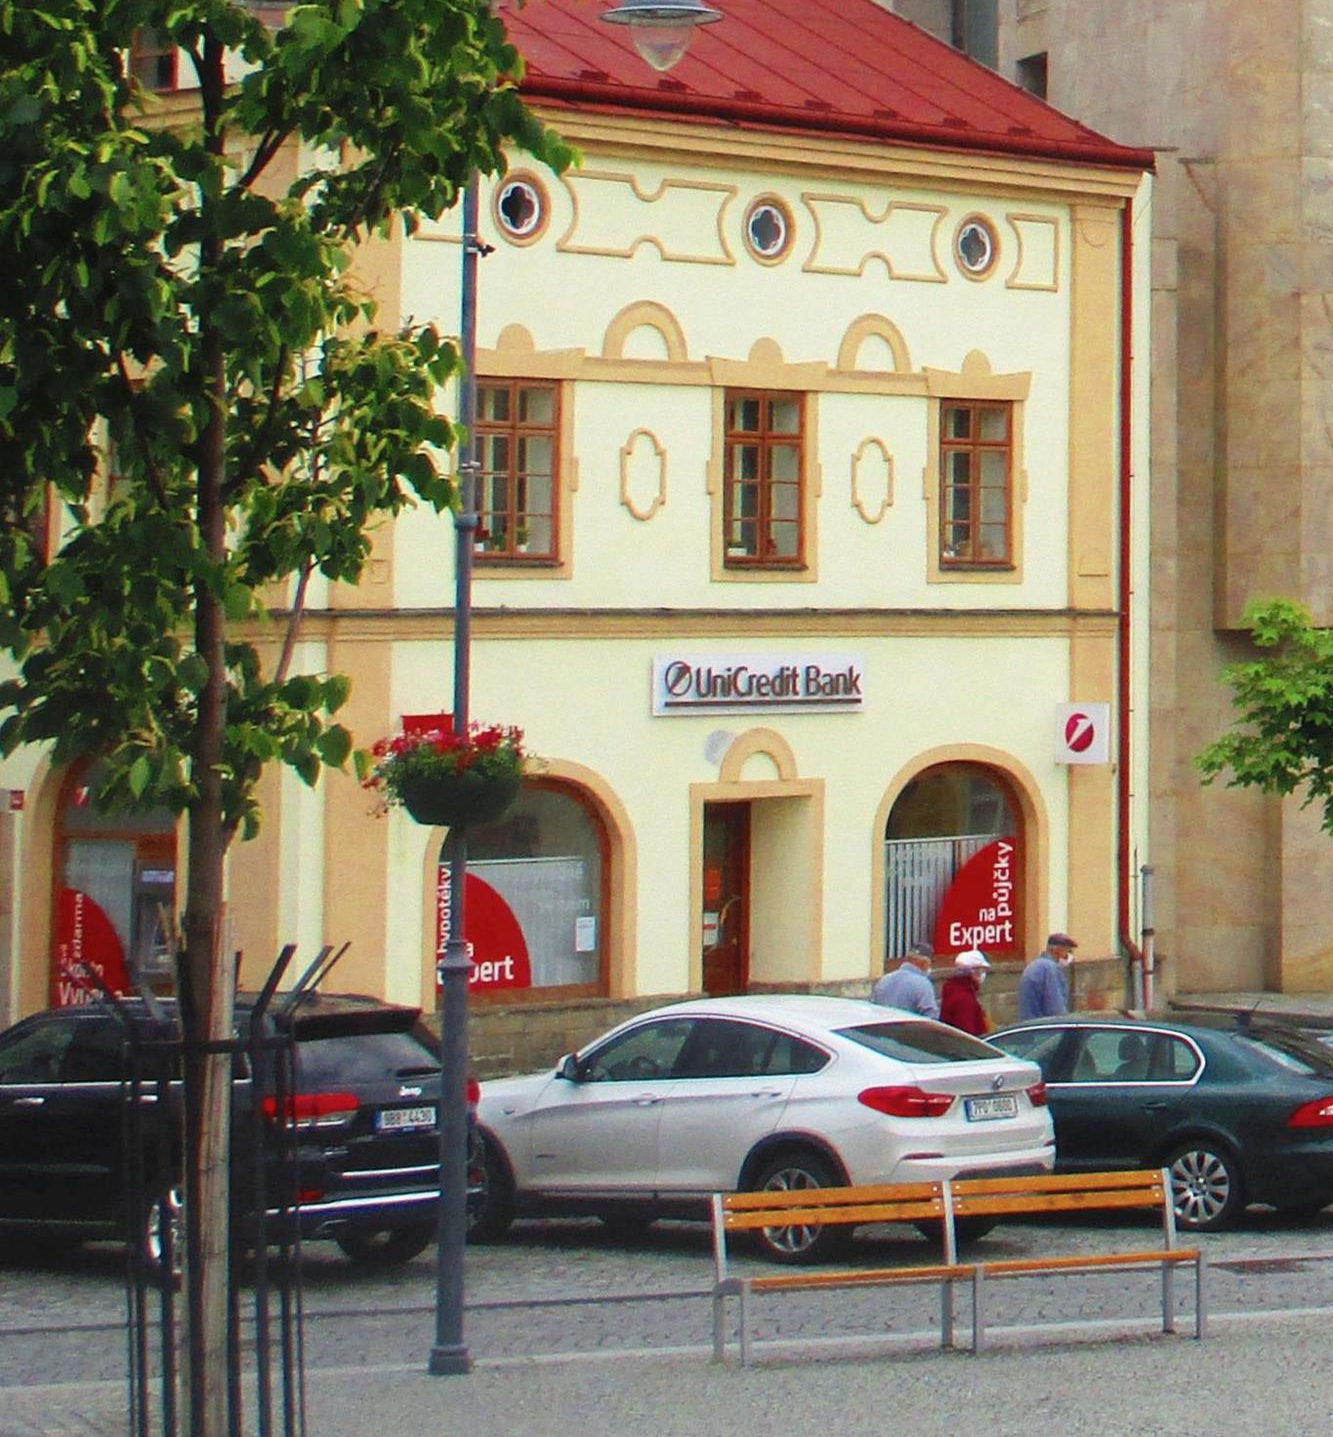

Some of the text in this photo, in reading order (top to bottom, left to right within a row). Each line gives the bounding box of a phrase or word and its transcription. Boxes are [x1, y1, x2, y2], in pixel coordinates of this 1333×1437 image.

[696, 665, 862, 698] UniCredit Bank
[992, 841, 1014, 917] půjčky
[979, 907, 997, 922] na
[949, 919, 1013, 951] Expert
